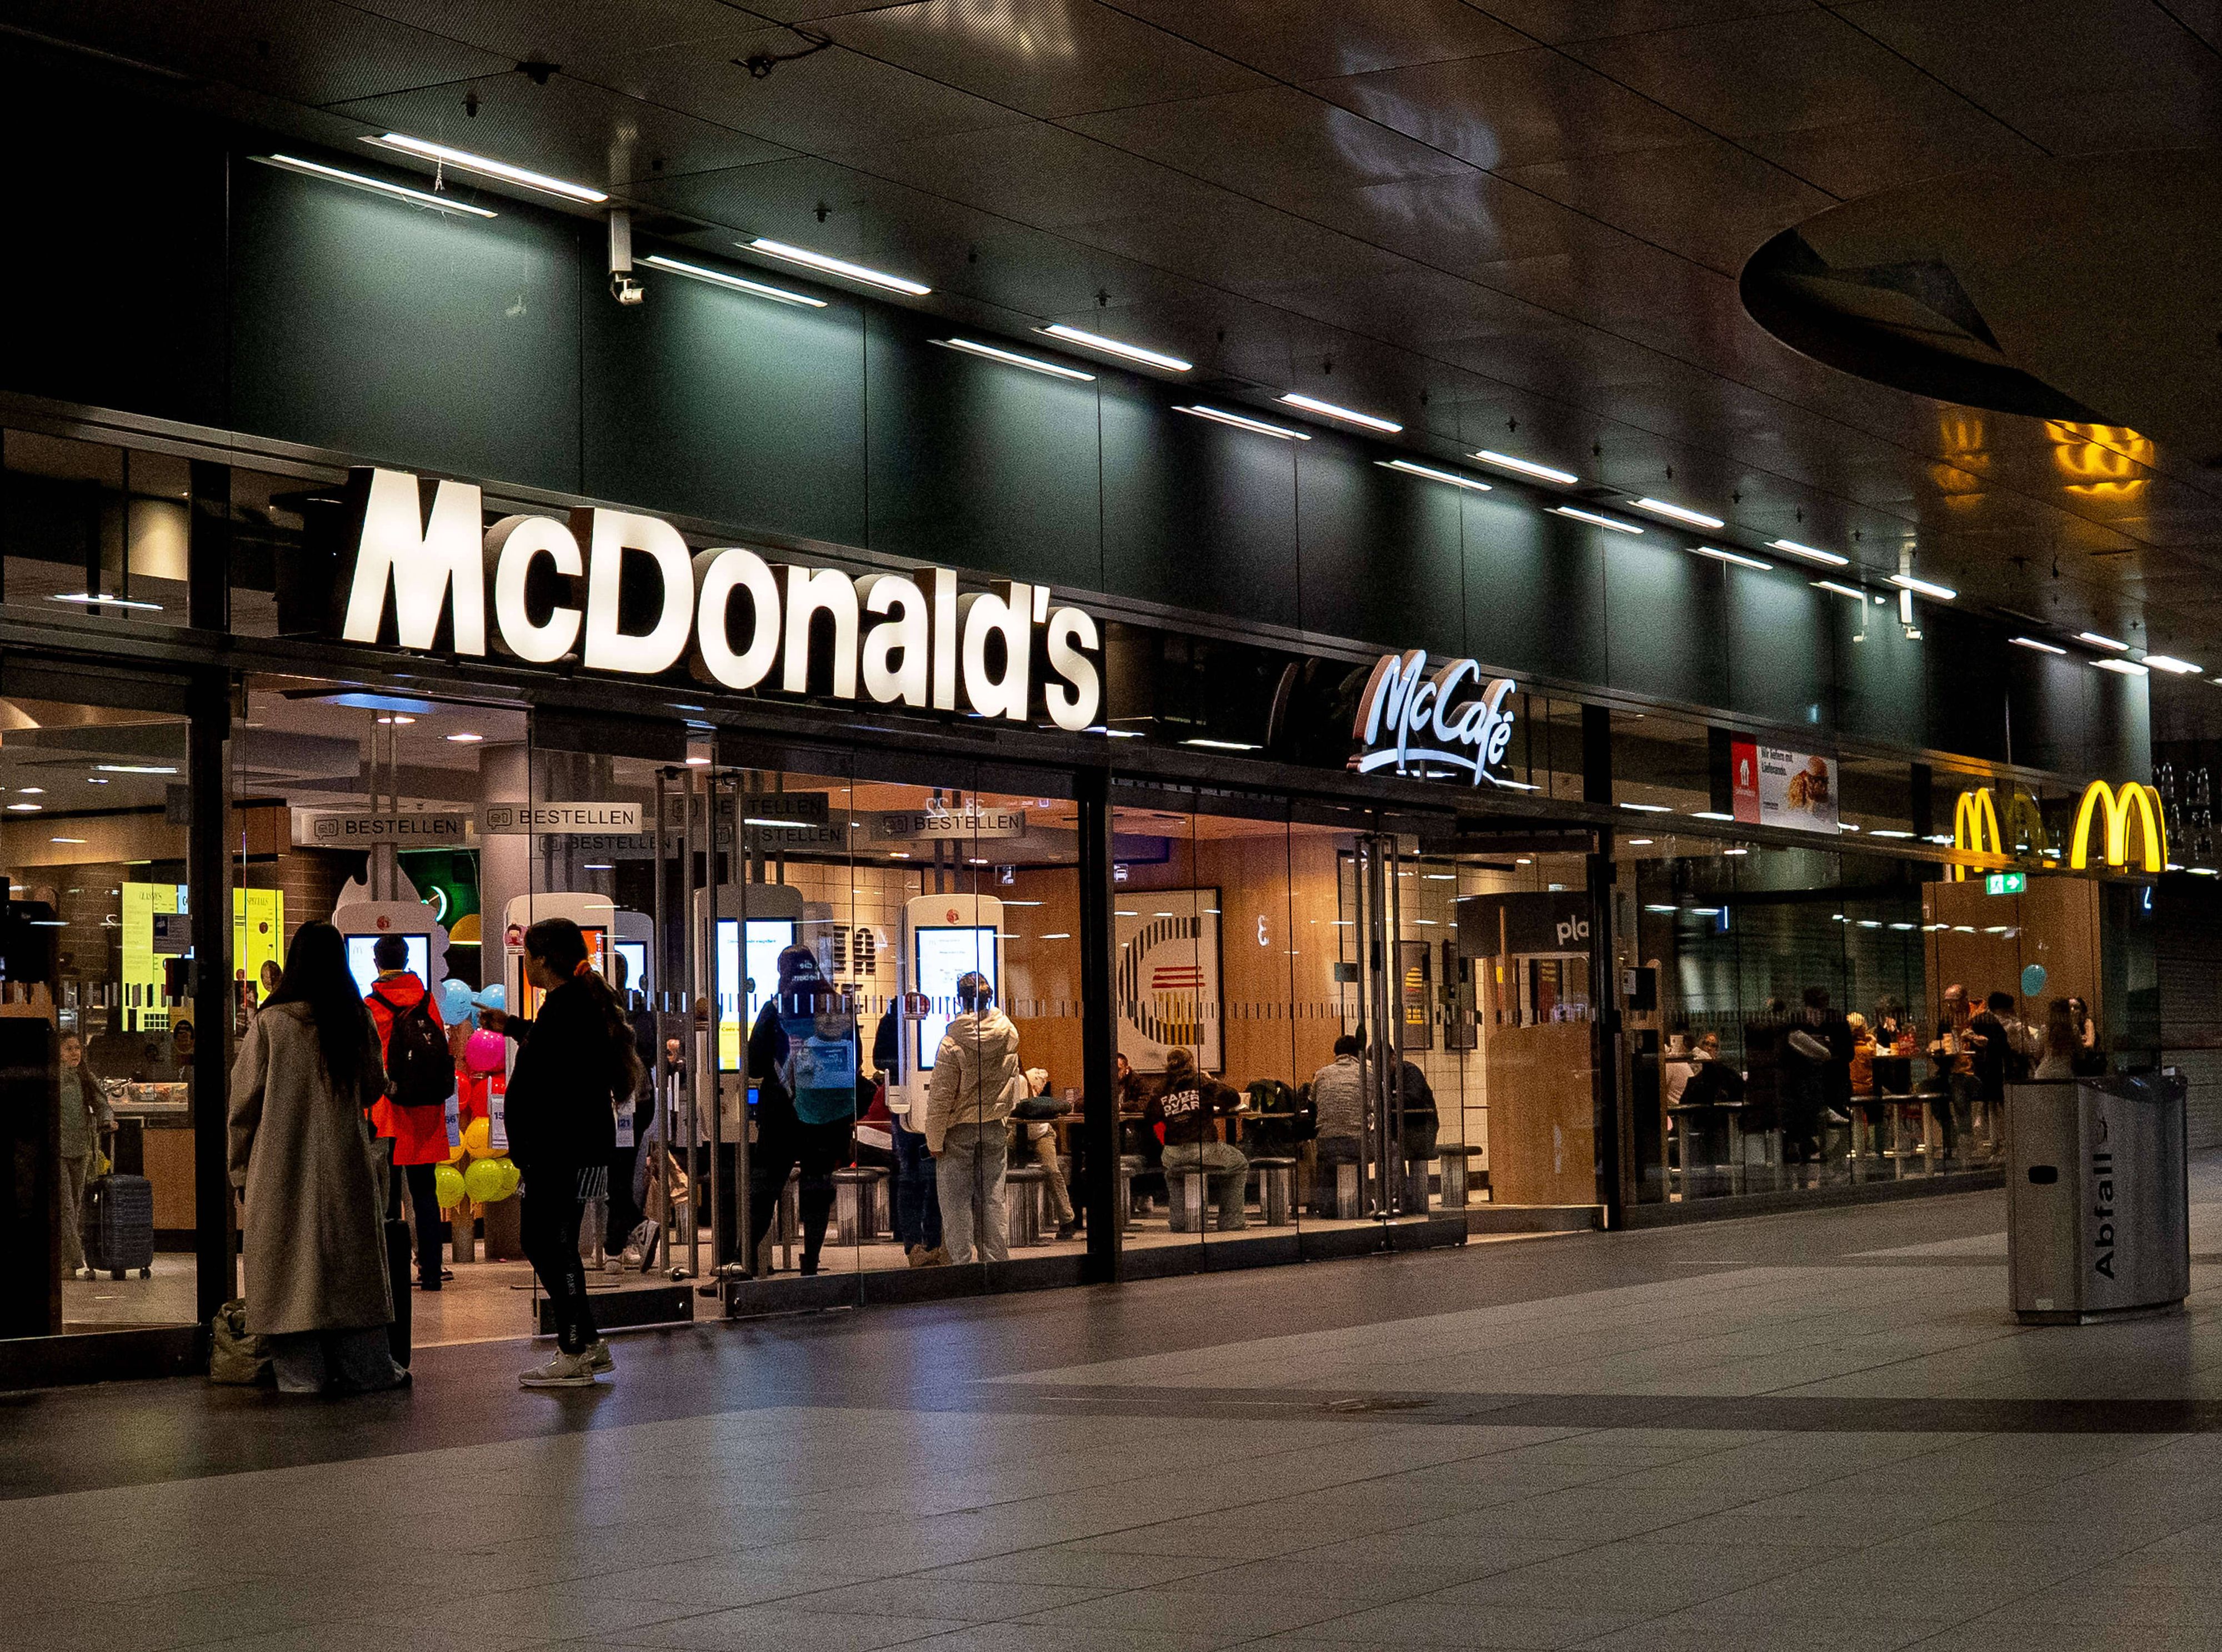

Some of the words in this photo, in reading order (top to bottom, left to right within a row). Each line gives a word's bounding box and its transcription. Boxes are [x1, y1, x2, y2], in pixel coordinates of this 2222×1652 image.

[343, 467, 1099, 732] McDonald's
[1353, 649, 1516, 787] McCafé
[346, 820, 457, 834] BESTELLEN
[520, 810, 633, 825] BESTELLEN
[915, 816, 1019, 830] BESTELLEN
[2093, 1154, 2115, 1280] Abfall
